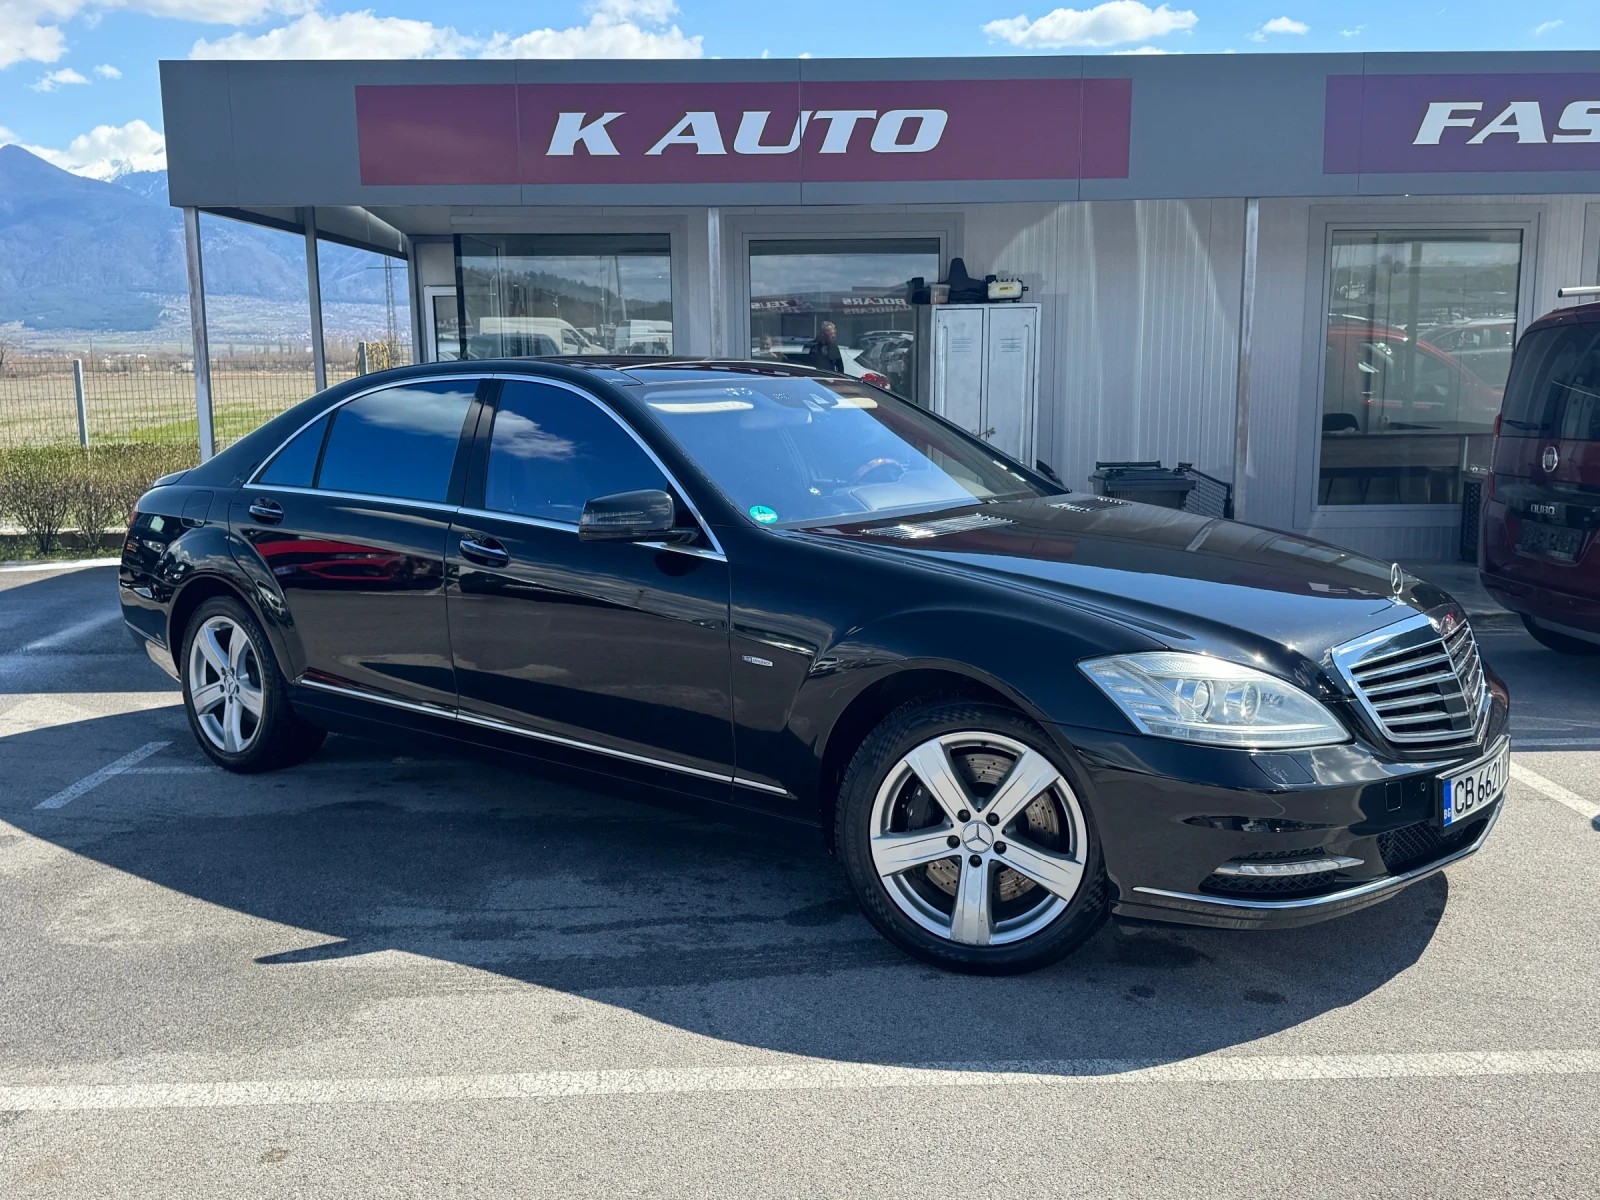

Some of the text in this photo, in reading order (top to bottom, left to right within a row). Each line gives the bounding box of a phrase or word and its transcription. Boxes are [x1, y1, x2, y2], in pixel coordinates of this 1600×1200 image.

[546, 109, 949, 156] K AUTO
[1412, 100, 1600, 145] FAS
[1443, 808, 1451, 820] BG
[1455, 776, 1475, 814] CB
